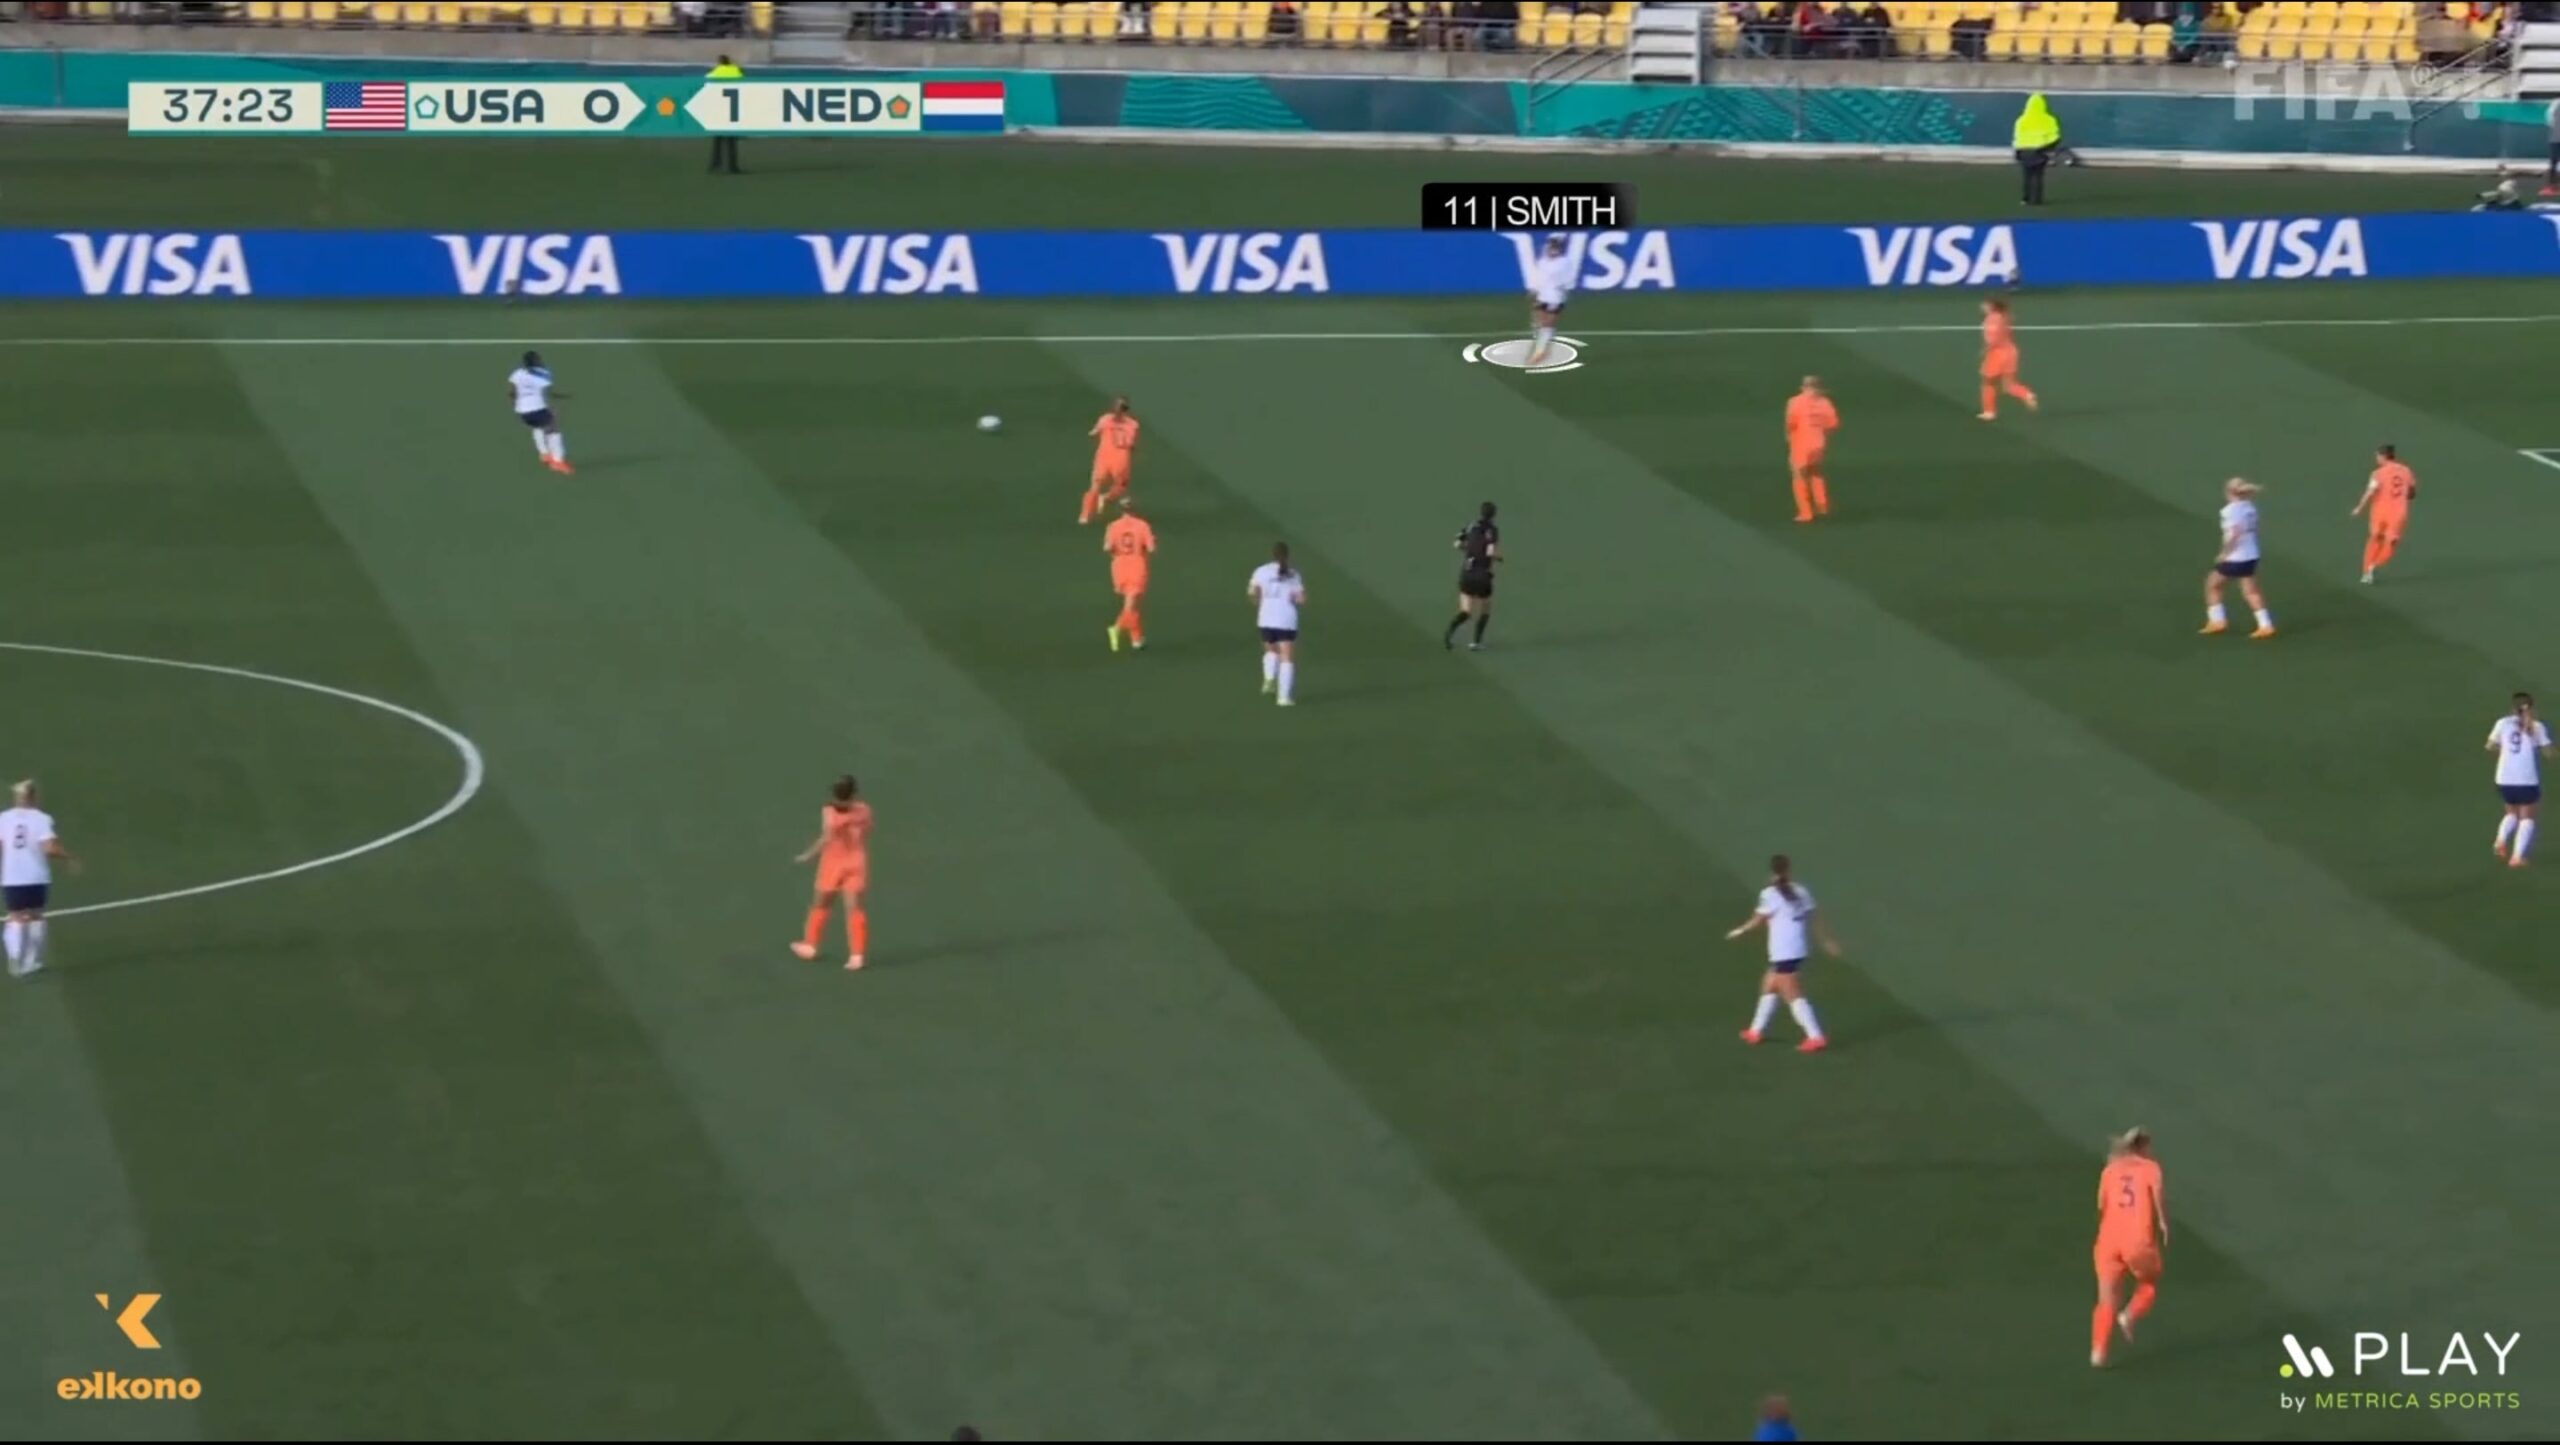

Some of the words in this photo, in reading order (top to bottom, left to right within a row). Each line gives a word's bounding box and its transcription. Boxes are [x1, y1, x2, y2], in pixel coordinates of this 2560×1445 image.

[55, 233, 252, 295] VISA
[431, 233, 622, 295] VISA
[794, 233, 979, 294] VISA
[1151, 232, 1329, 292] VISA
[1843, 225, 2018, 285] VISA
[2189, 217, 2368, 279] VISA
[2510, 731, 2521, 754] 9
[2118, 1175, 2135, 1208] 3
